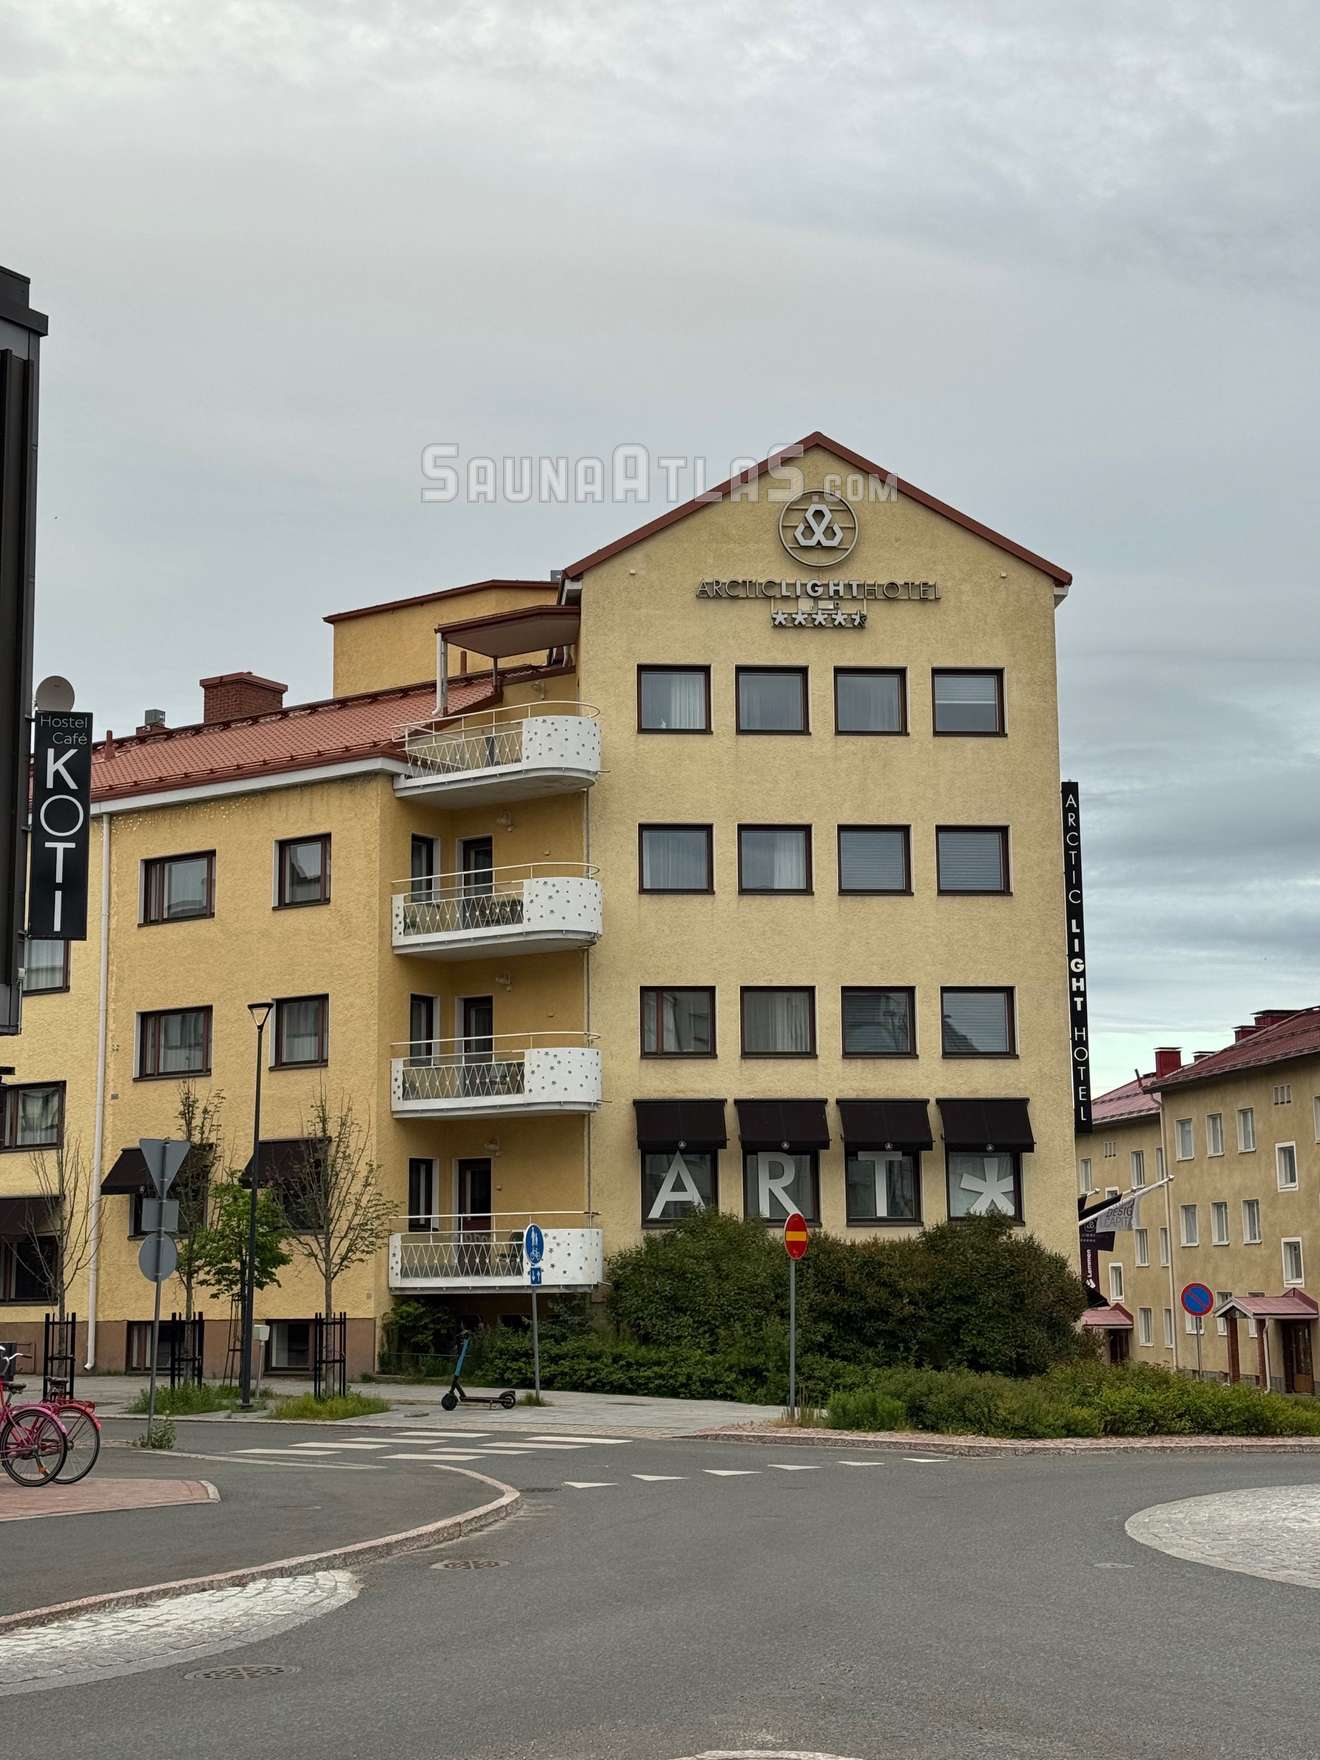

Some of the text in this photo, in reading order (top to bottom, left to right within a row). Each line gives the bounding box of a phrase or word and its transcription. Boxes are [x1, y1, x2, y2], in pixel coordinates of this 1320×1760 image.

[41, 715, 88, 729] Hostel
[52, 731, 88, 745] Café
[40, 748, 84, 932] KOTI
[1065, 794, 1088, 1121] ARCTIC LIGHT HOTEL
